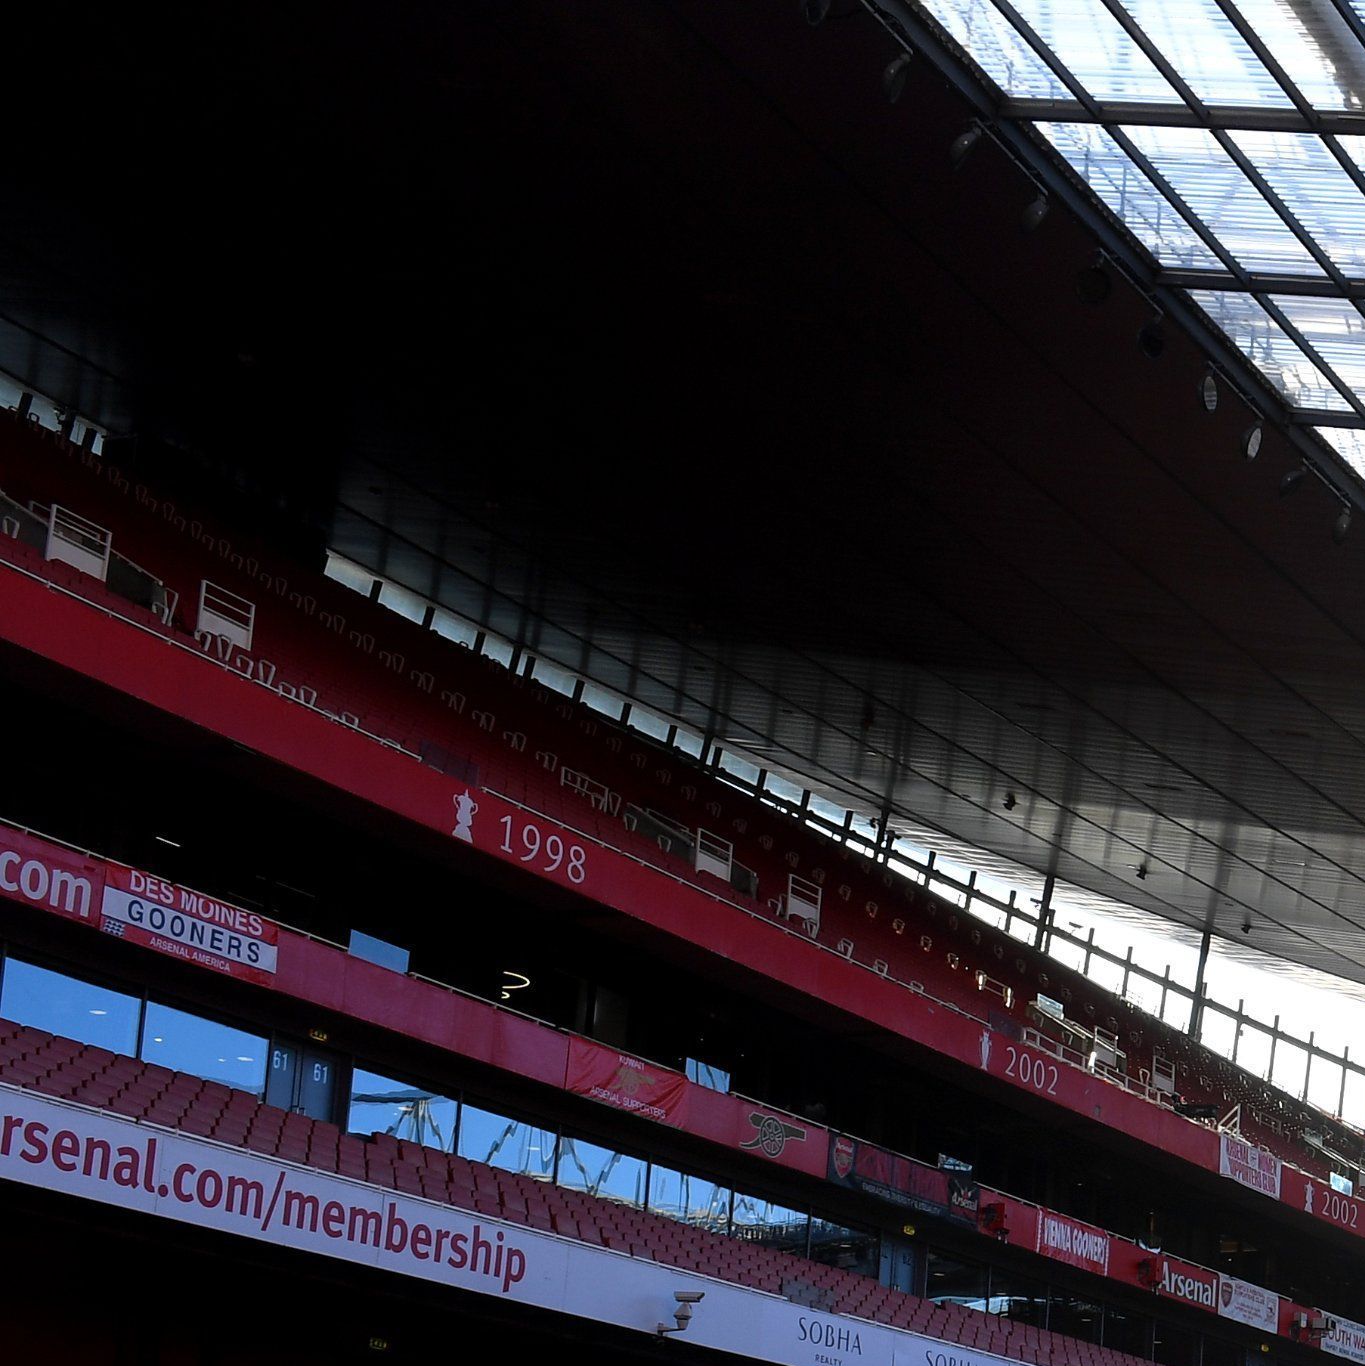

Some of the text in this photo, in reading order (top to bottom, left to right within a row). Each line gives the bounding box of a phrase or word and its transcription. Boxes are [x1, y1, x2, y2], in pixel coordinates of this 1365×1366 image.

[500, 814, 587, 884] 1998
[130, 870, 263, 936] DES MOINES
[128, 900, 260, 964] GOONERS
[150, 937, 231, 972] ARSENAL AMERICA
[273, 1050, 288, 1071] 61
[313, 1063, 328, 1084] 61
[1005, 1047, 1059, 1095] 2002
[590, 1085, 667, 1119] ARSENAL SUPPORTERS
[1, 1115, 527, 1292] rsenal.com/membership
[1322, 1192, 1358, 1228] 2002
[1044, 1217, 1071, 1252] VIENNA
[1161, 1261, 1217, 1308] Arsenal
[798, 1317, 862, 1355] SOBHA
[1328, 1326, 1352, 1347] OUTH
[815, 1354, 842, 1366] REALTY
